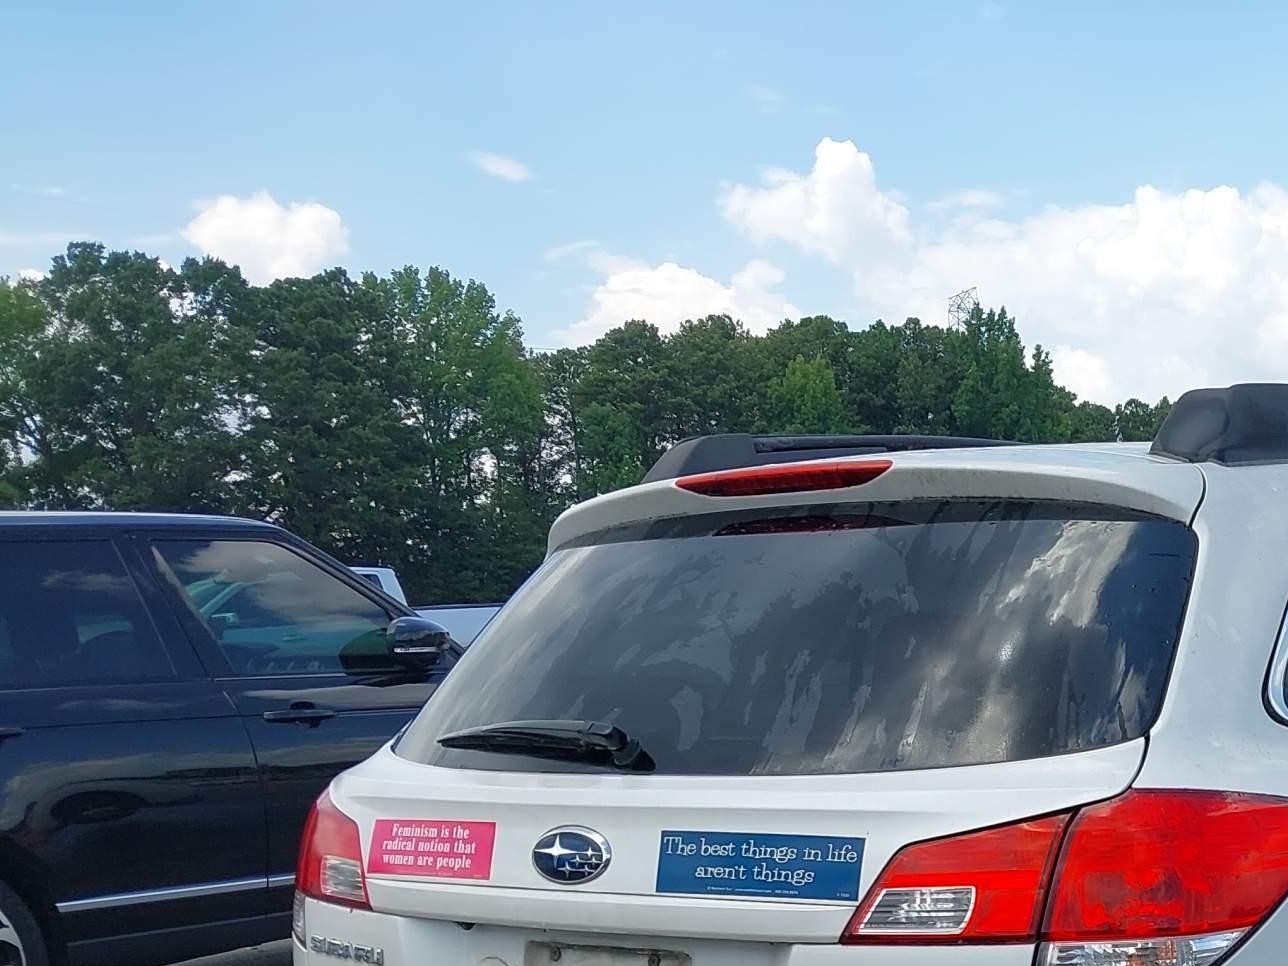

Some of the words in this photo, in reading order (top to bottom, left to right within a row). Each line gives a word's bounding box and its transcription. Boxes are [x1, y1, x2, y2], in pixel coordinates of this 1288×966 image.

[391, 823, 437, 837] Feminism
[440, 825, 449, 838] is
[452, 825, 470, 839] the
[382, 837, 415, 851] radical
[417, 840, 450, 853] notion
[453, 840, 476, 854] that
[664, 836, 696, 856] The
[700, 838, 735, 857] best
[741, 840, 797, 863] things
[803, 847, 822, 861] in
[828, 844, 857, 863] life
[382, 854, 414, 865] women
[416, 855, 433, 866] are
[436, 855, 471, 871] people
[695, 864, 747, 880] aren't
[752, 863, 815, 886] things
